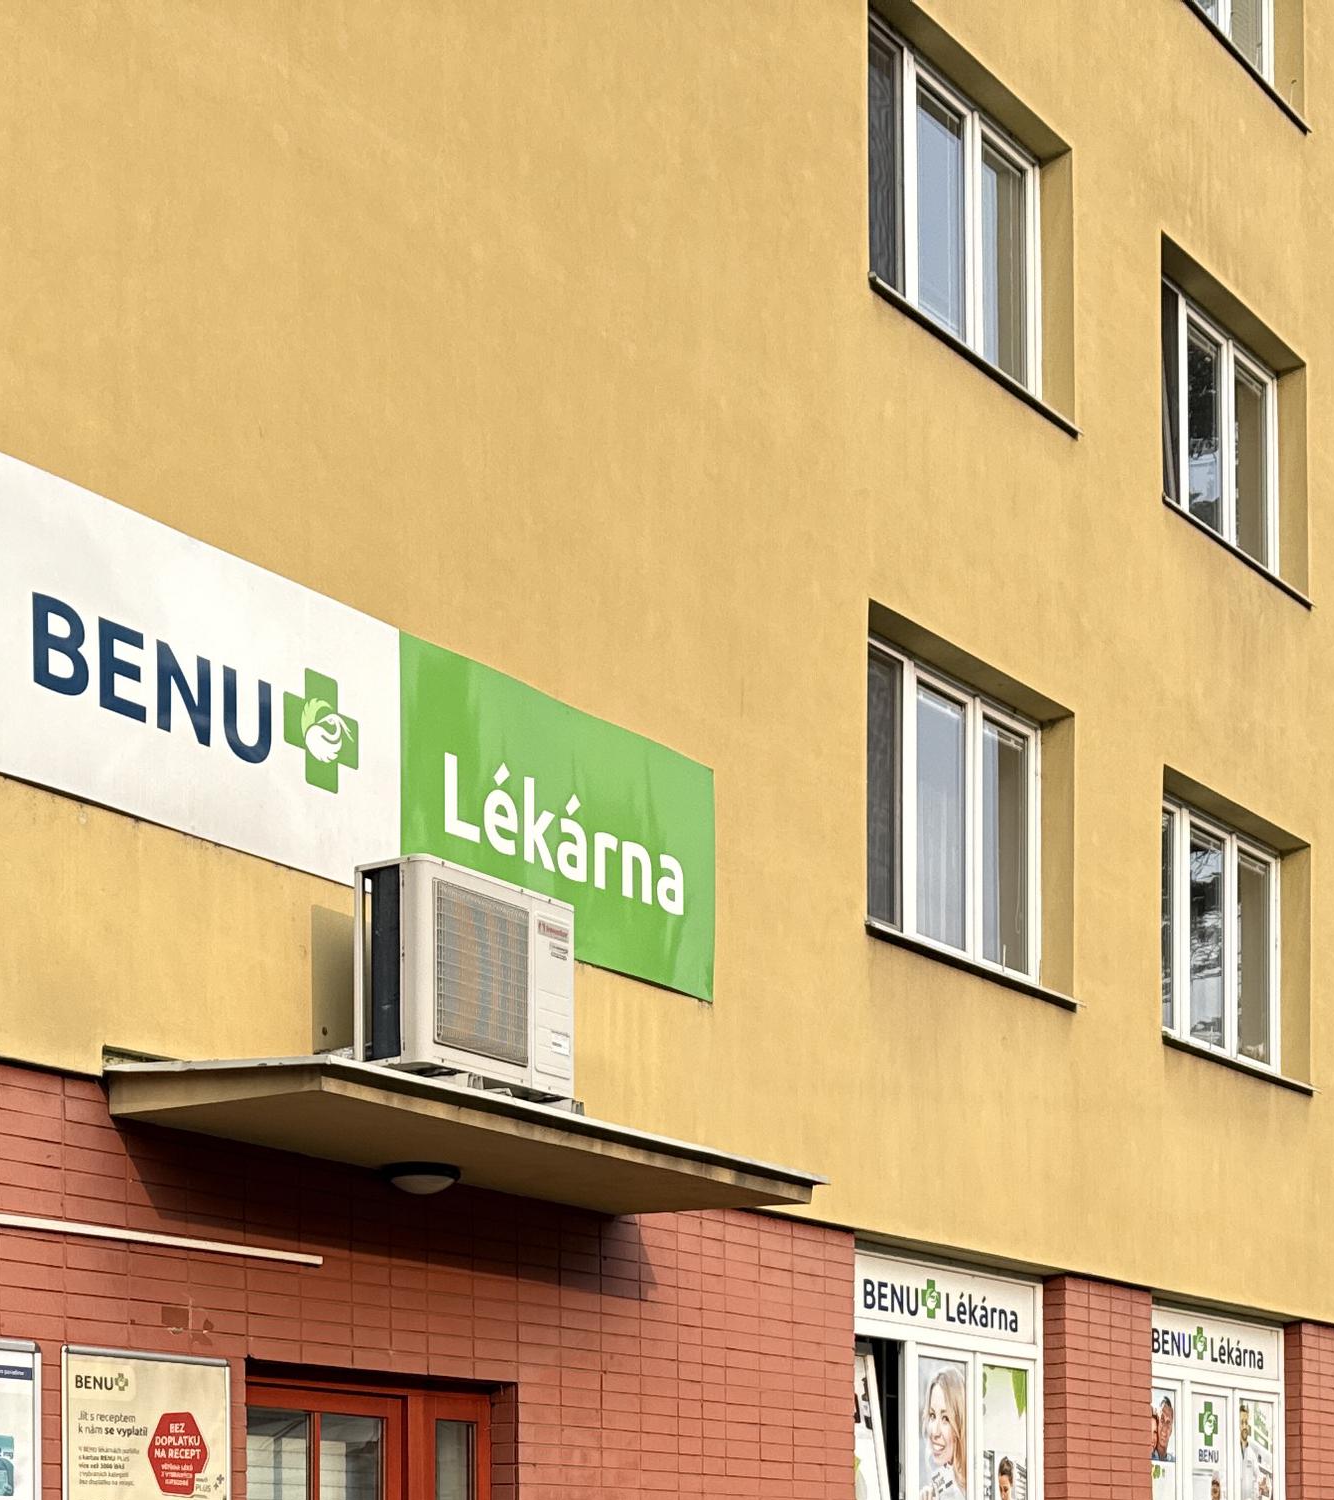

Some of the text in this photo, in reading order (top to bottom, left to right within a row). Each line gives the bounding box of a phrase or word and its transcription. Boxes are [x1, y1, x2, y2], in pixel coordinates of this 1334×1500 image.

[31, 591, 272, 764] BENU
[443, 752, 685, 916] Lékárna
[863, 1278, 1019, 1333] BENU Lékárna
[1151, 1328, 1264, 1370] BENU Lékárna
[75, 1374, 114, 1391] BENU
[78, 1410, 89, 1421] Jít
[96, 1412, 136, 1424] receptem
[78, 1423, 83, 1433] k
[85, 1424, 103, 1434] nám
[104, 1427, 115, 1435] se
[169, 1423, 185, 1433] BEZ
[154, 1435, 201, 1446] DOPLATKU
[3, 1451, 14, 1459] mg
[154, 1448, 201, 1460] NA RECEPT
[1198, 1448, 1219, 1464] BENU
[196, 1484, 212, 1492] PLUS
